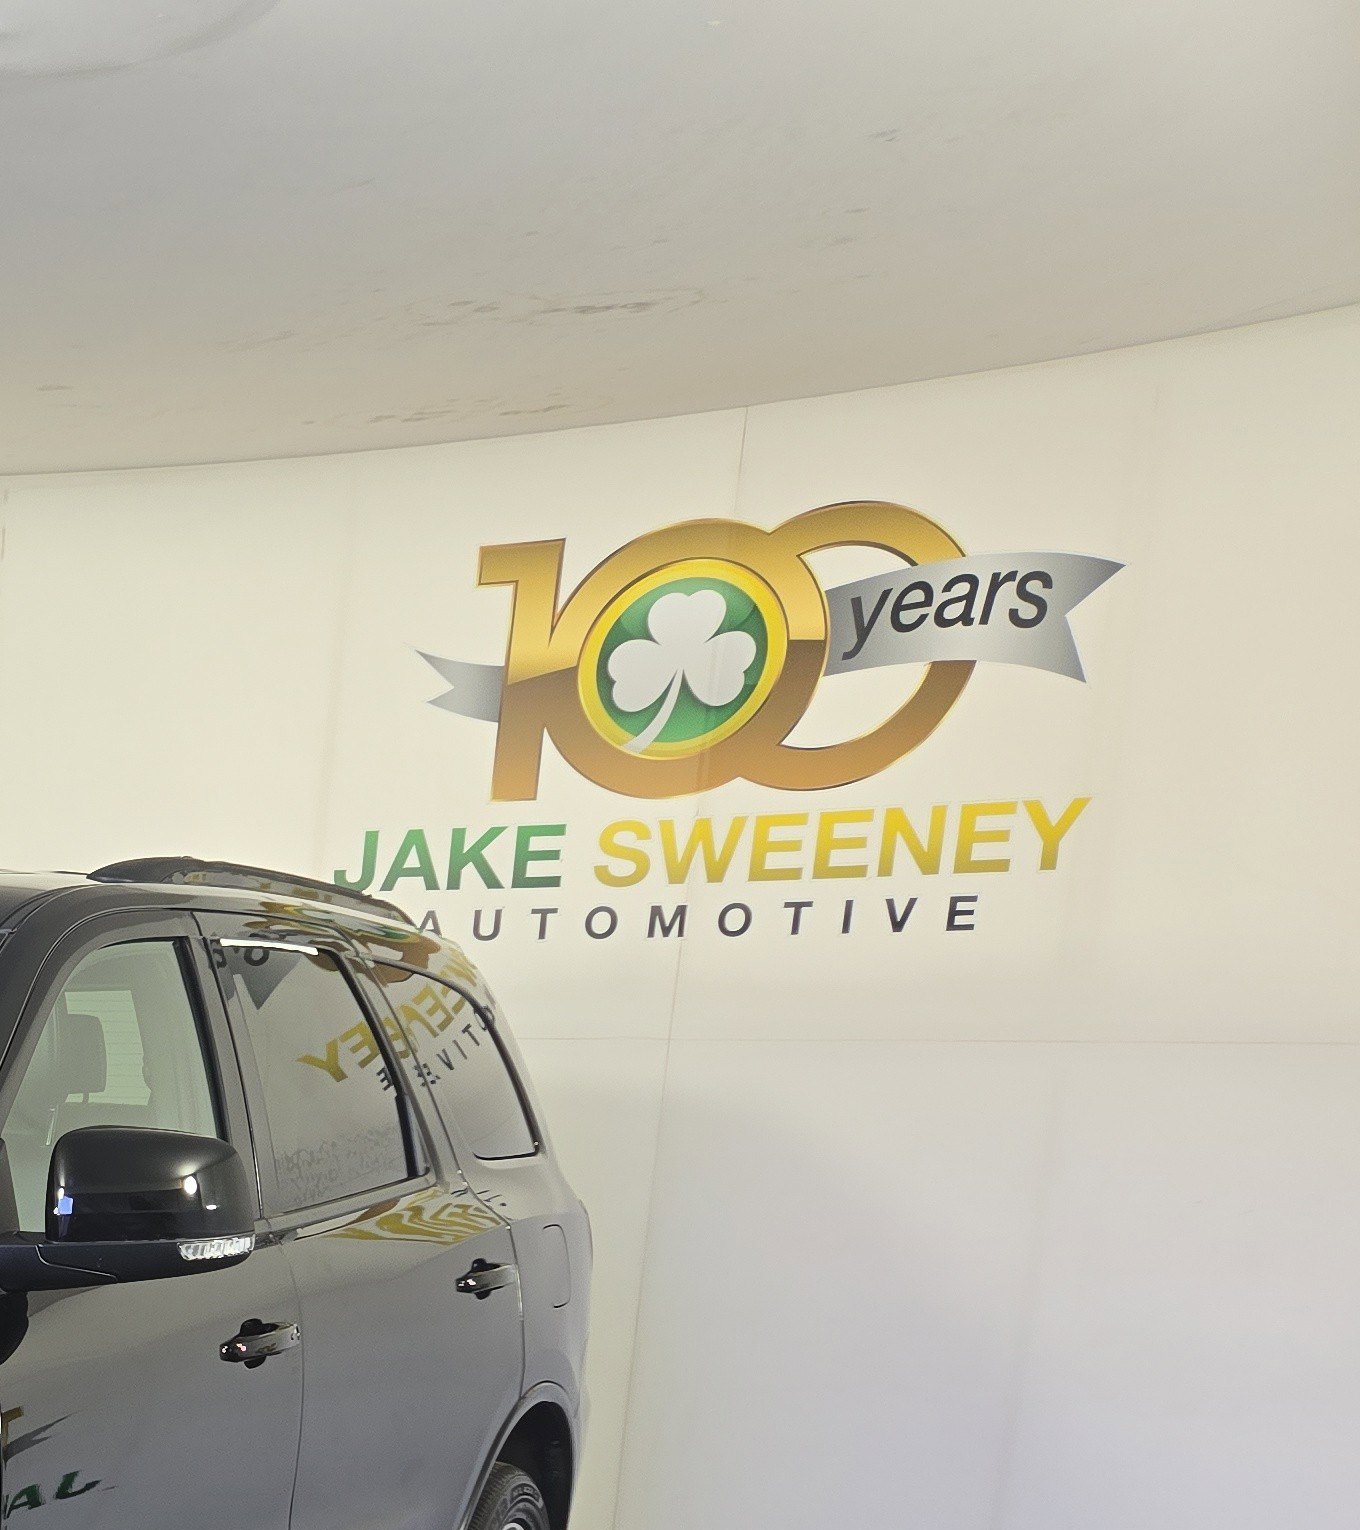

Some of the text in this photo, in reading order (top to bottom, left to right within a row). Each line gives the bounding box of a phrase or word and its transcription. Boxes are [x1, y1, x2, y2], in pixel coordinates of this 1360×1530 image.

[478, 500, 978, 802] 100
[842, 568, 1054, 660] years
[334, 796, 1092, 893] JAKE SWEENEY
[419, 894, 980, 942] AUTOMOTIVE
